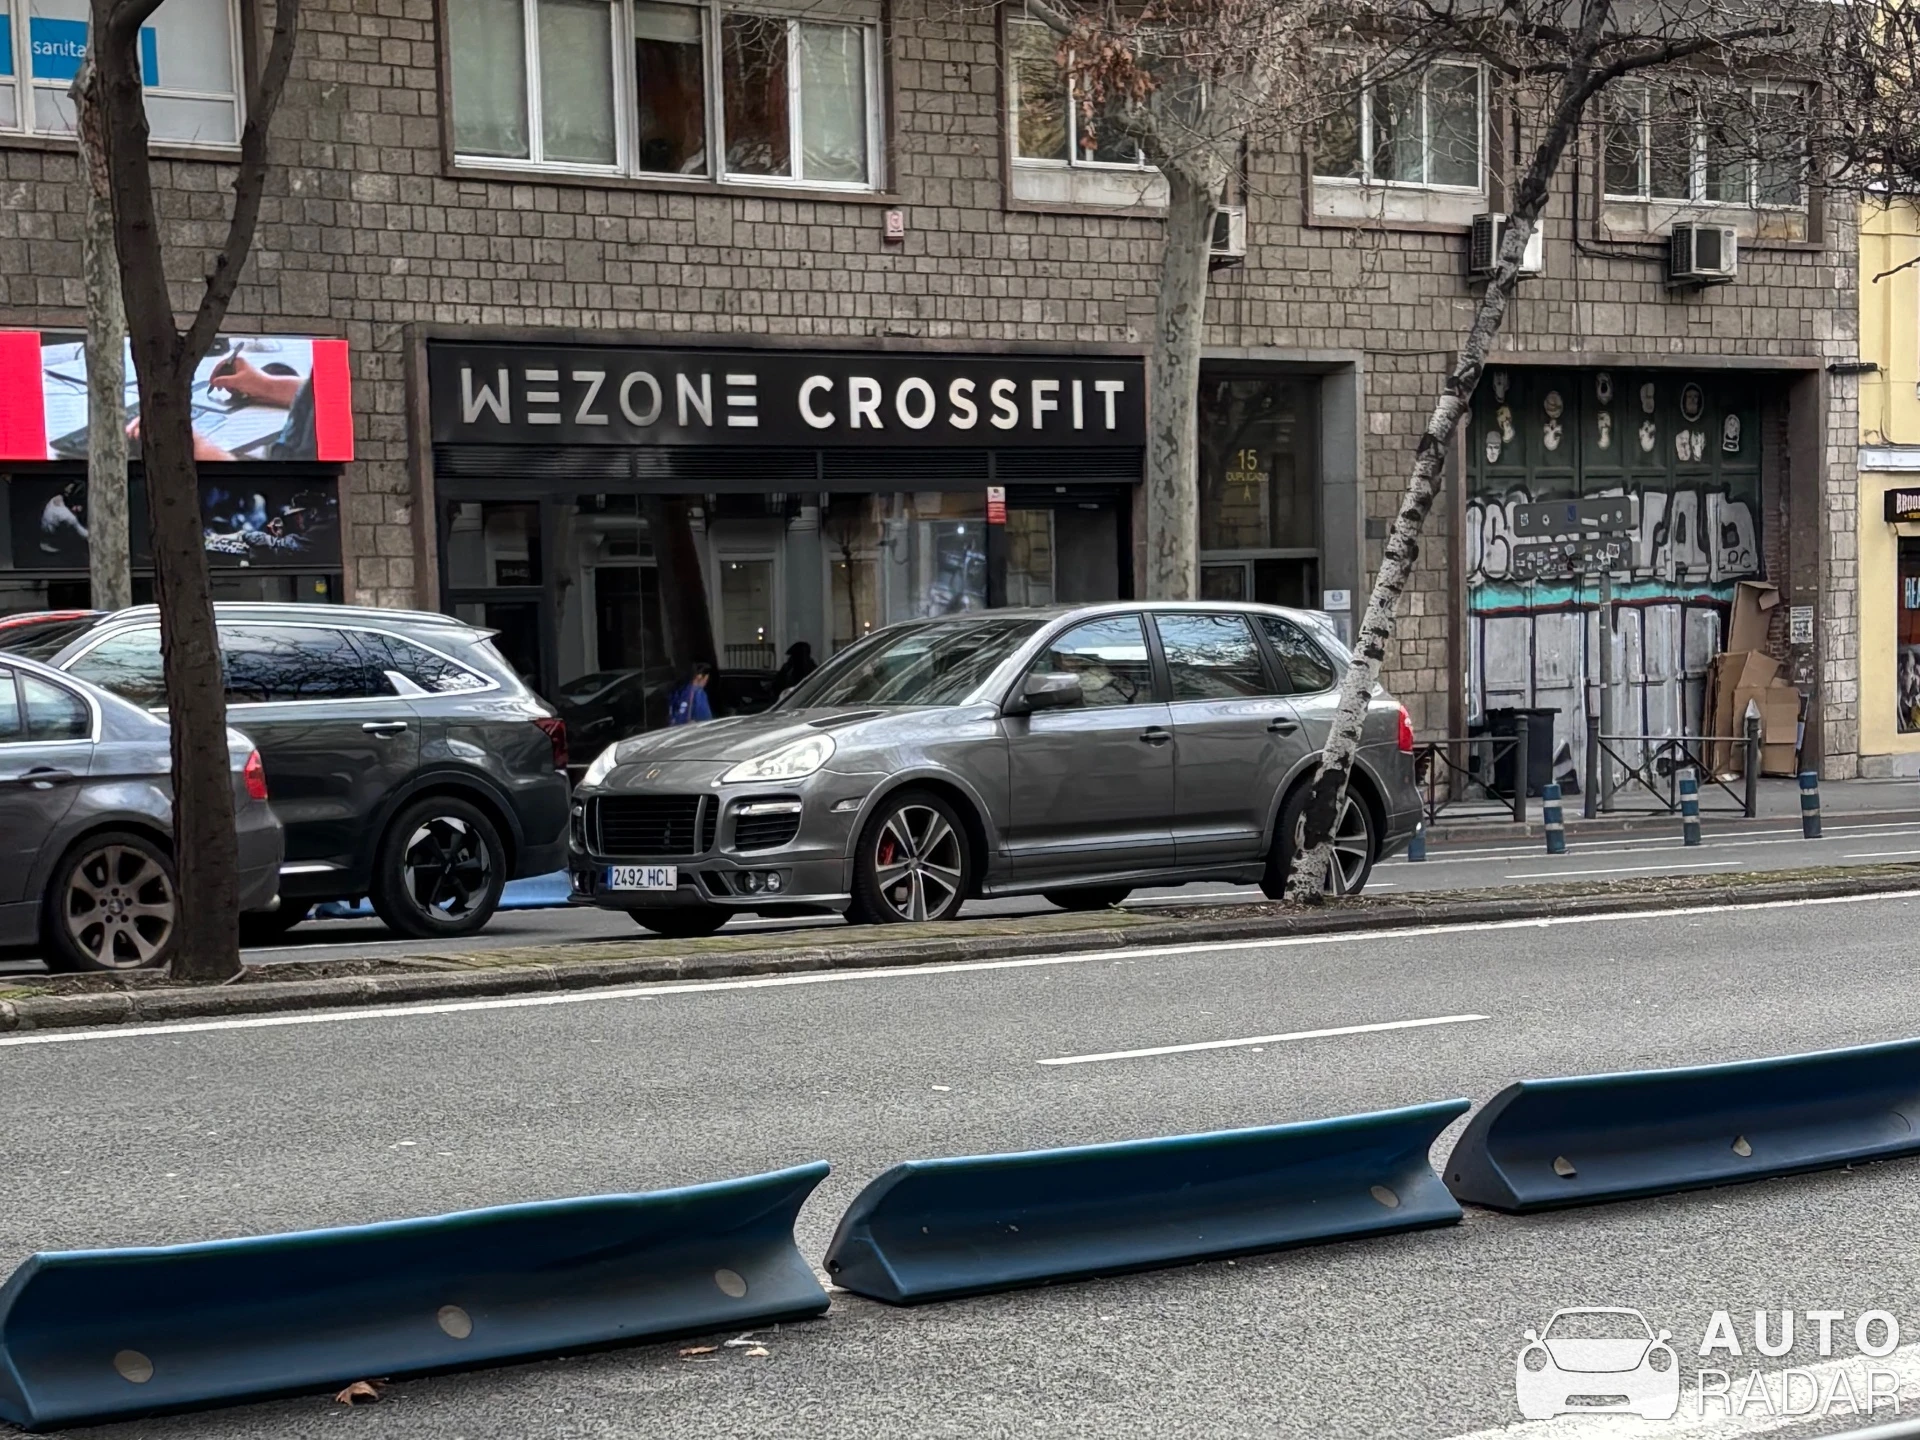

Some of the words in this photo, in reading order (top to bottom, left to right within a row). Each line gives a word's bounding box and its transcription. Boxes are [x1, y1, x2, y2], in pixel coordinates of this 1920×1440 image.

[33, 40, 87, 58] sanita
[460, 367, 759, 428] WEZONE
[798, 375, 1125, 430] CROSSFIT
[1237, 449, 1257, 470] 15
[614, 868, 643, 887] 2492
[648, 868, 674, 887] HCL
